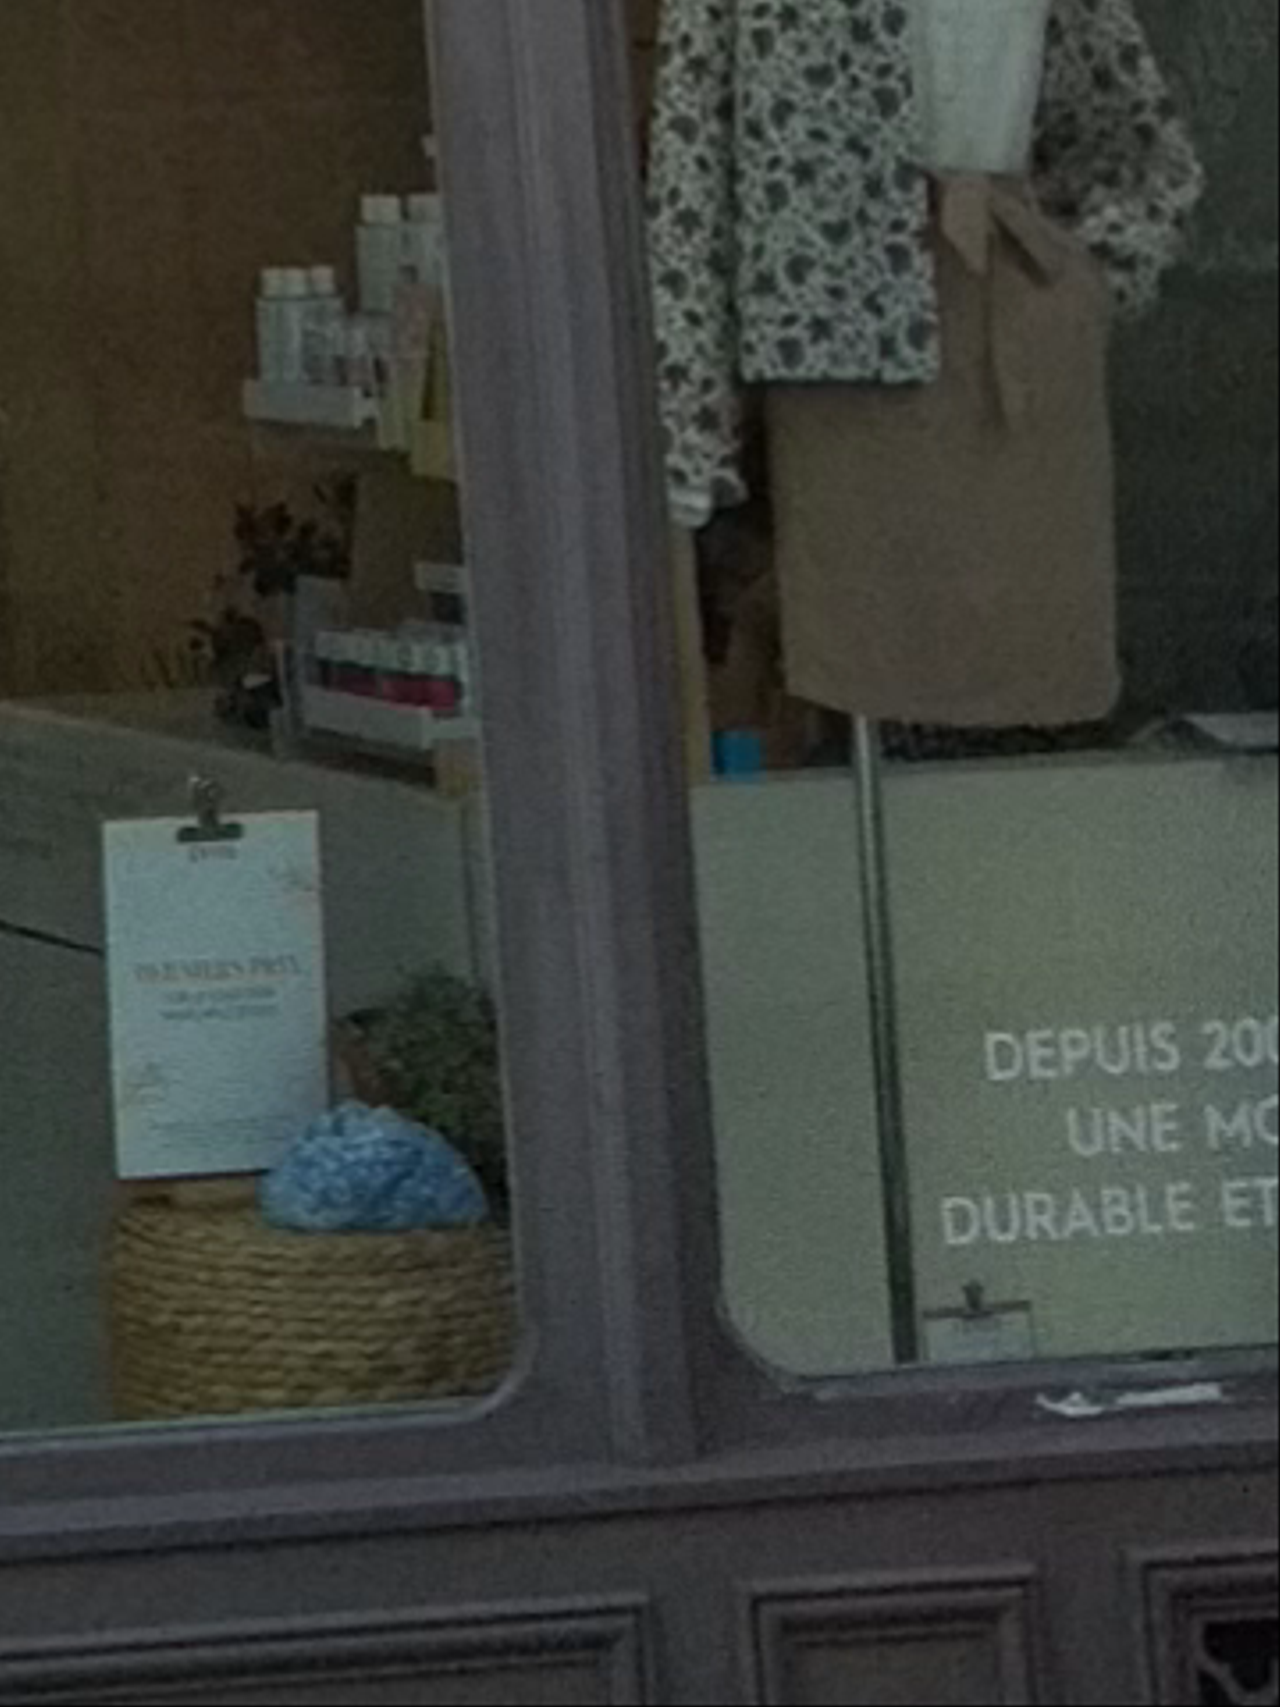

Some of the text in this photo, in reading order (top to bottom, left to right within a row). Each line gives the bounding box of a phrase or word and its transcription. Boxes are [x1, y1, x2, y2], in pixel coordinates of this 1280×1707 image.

[984, 1022, 1181, 1081] DEPUIS
[1065, 1101, 1180, 1157] UNE
[940, 1181, 1195, 1245] DURABLE
